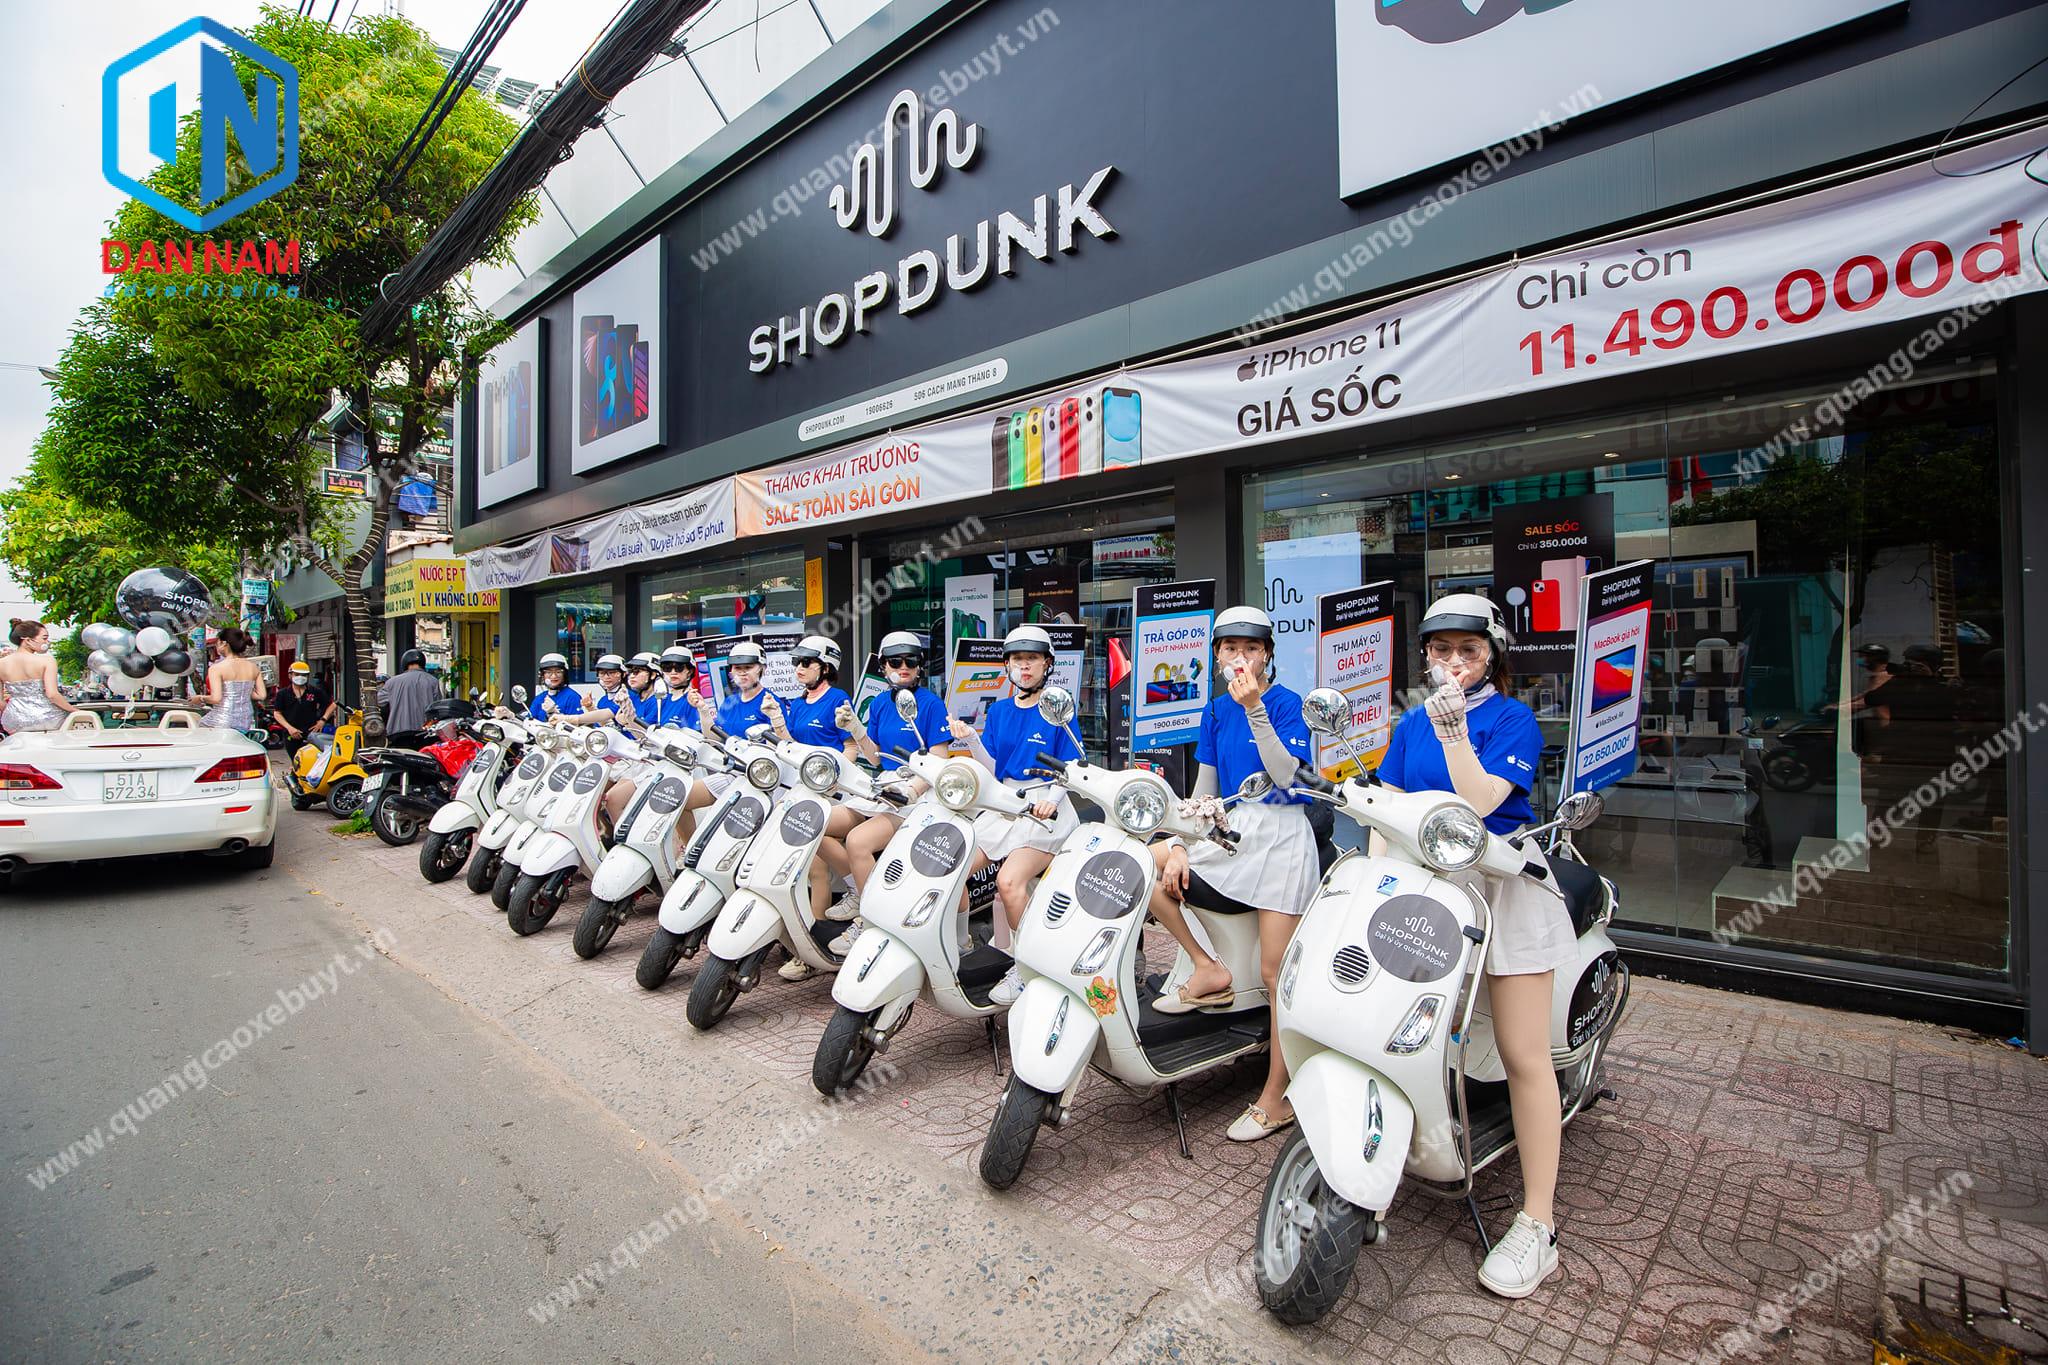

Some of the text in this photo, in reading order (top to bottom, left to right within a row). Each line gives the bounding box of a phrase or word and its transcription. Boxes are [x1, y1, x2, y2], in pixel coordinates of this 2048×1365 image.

[749, 165, 1118, 374] SHOPDUNK
[1517, 248, 1692, 310] Chỉ còn
[1519, 219, 2023, 376] 11.490.000đ
[1261, 318, 1402, 377] iPhone 11
[1237, 364, 1402, 437] GIÁ SỐC
[765, 442, 921, 497] THÁNG KHAI TRƯƠNG
[765, 474, 921, 527] SALE TOÀN SÀI GÒN
[1524, 524, 1553, 536] SALE
[1539, 536, 1588, 549] 350.000đ
[420, 565, 443, 581] NƯỚC
[446, 564, 458, 581] ÉP
[420, 592, 432, 607] LY
[434, 585, 465, 607] KHỔNG
[481, 592, 498, 607] 20K
[1153, 589, 1200, 601] SHOPDUNK
[1602, 575, 1642, 595] SHOPDUNK
[1335, 594, 1380, 611] SHOPDUNK
[1143, 627, 1206, 644] TRẢ GÓP 0%
[1332, 632, 1382, 655] THU MÁY CŨ
[1594, 629, 1621, 651] MacBook
[1621, 626, 1631, 643] giá
[1144, 647, 1150, 655] 5
[1150, 644, 1169, 654] PHÚT
[1539, 643, 1560, 651] APPLE
[1337, 646, 1376, 671] GIÁ TỐT
[964, 682, 983, 690] SALE
[1153, 717, 1191, 730] 1900.6626
[1351, 706, 1382, 728] TRIỆU
[117, 773, 145, 786] 51A
[105, 786, 156, 801] 572.34
[918, 839, 956, 865] SHOPDUNK
[1084, 872, 1134, 902] SHOPDUNK
[1374, 930, 1387, 940] Đại
[1386, 936, 1393, 944] lý
[1425, 955, 1446, 969] Apple
[1378, 921, 1450, 960] SHOPDUNK
